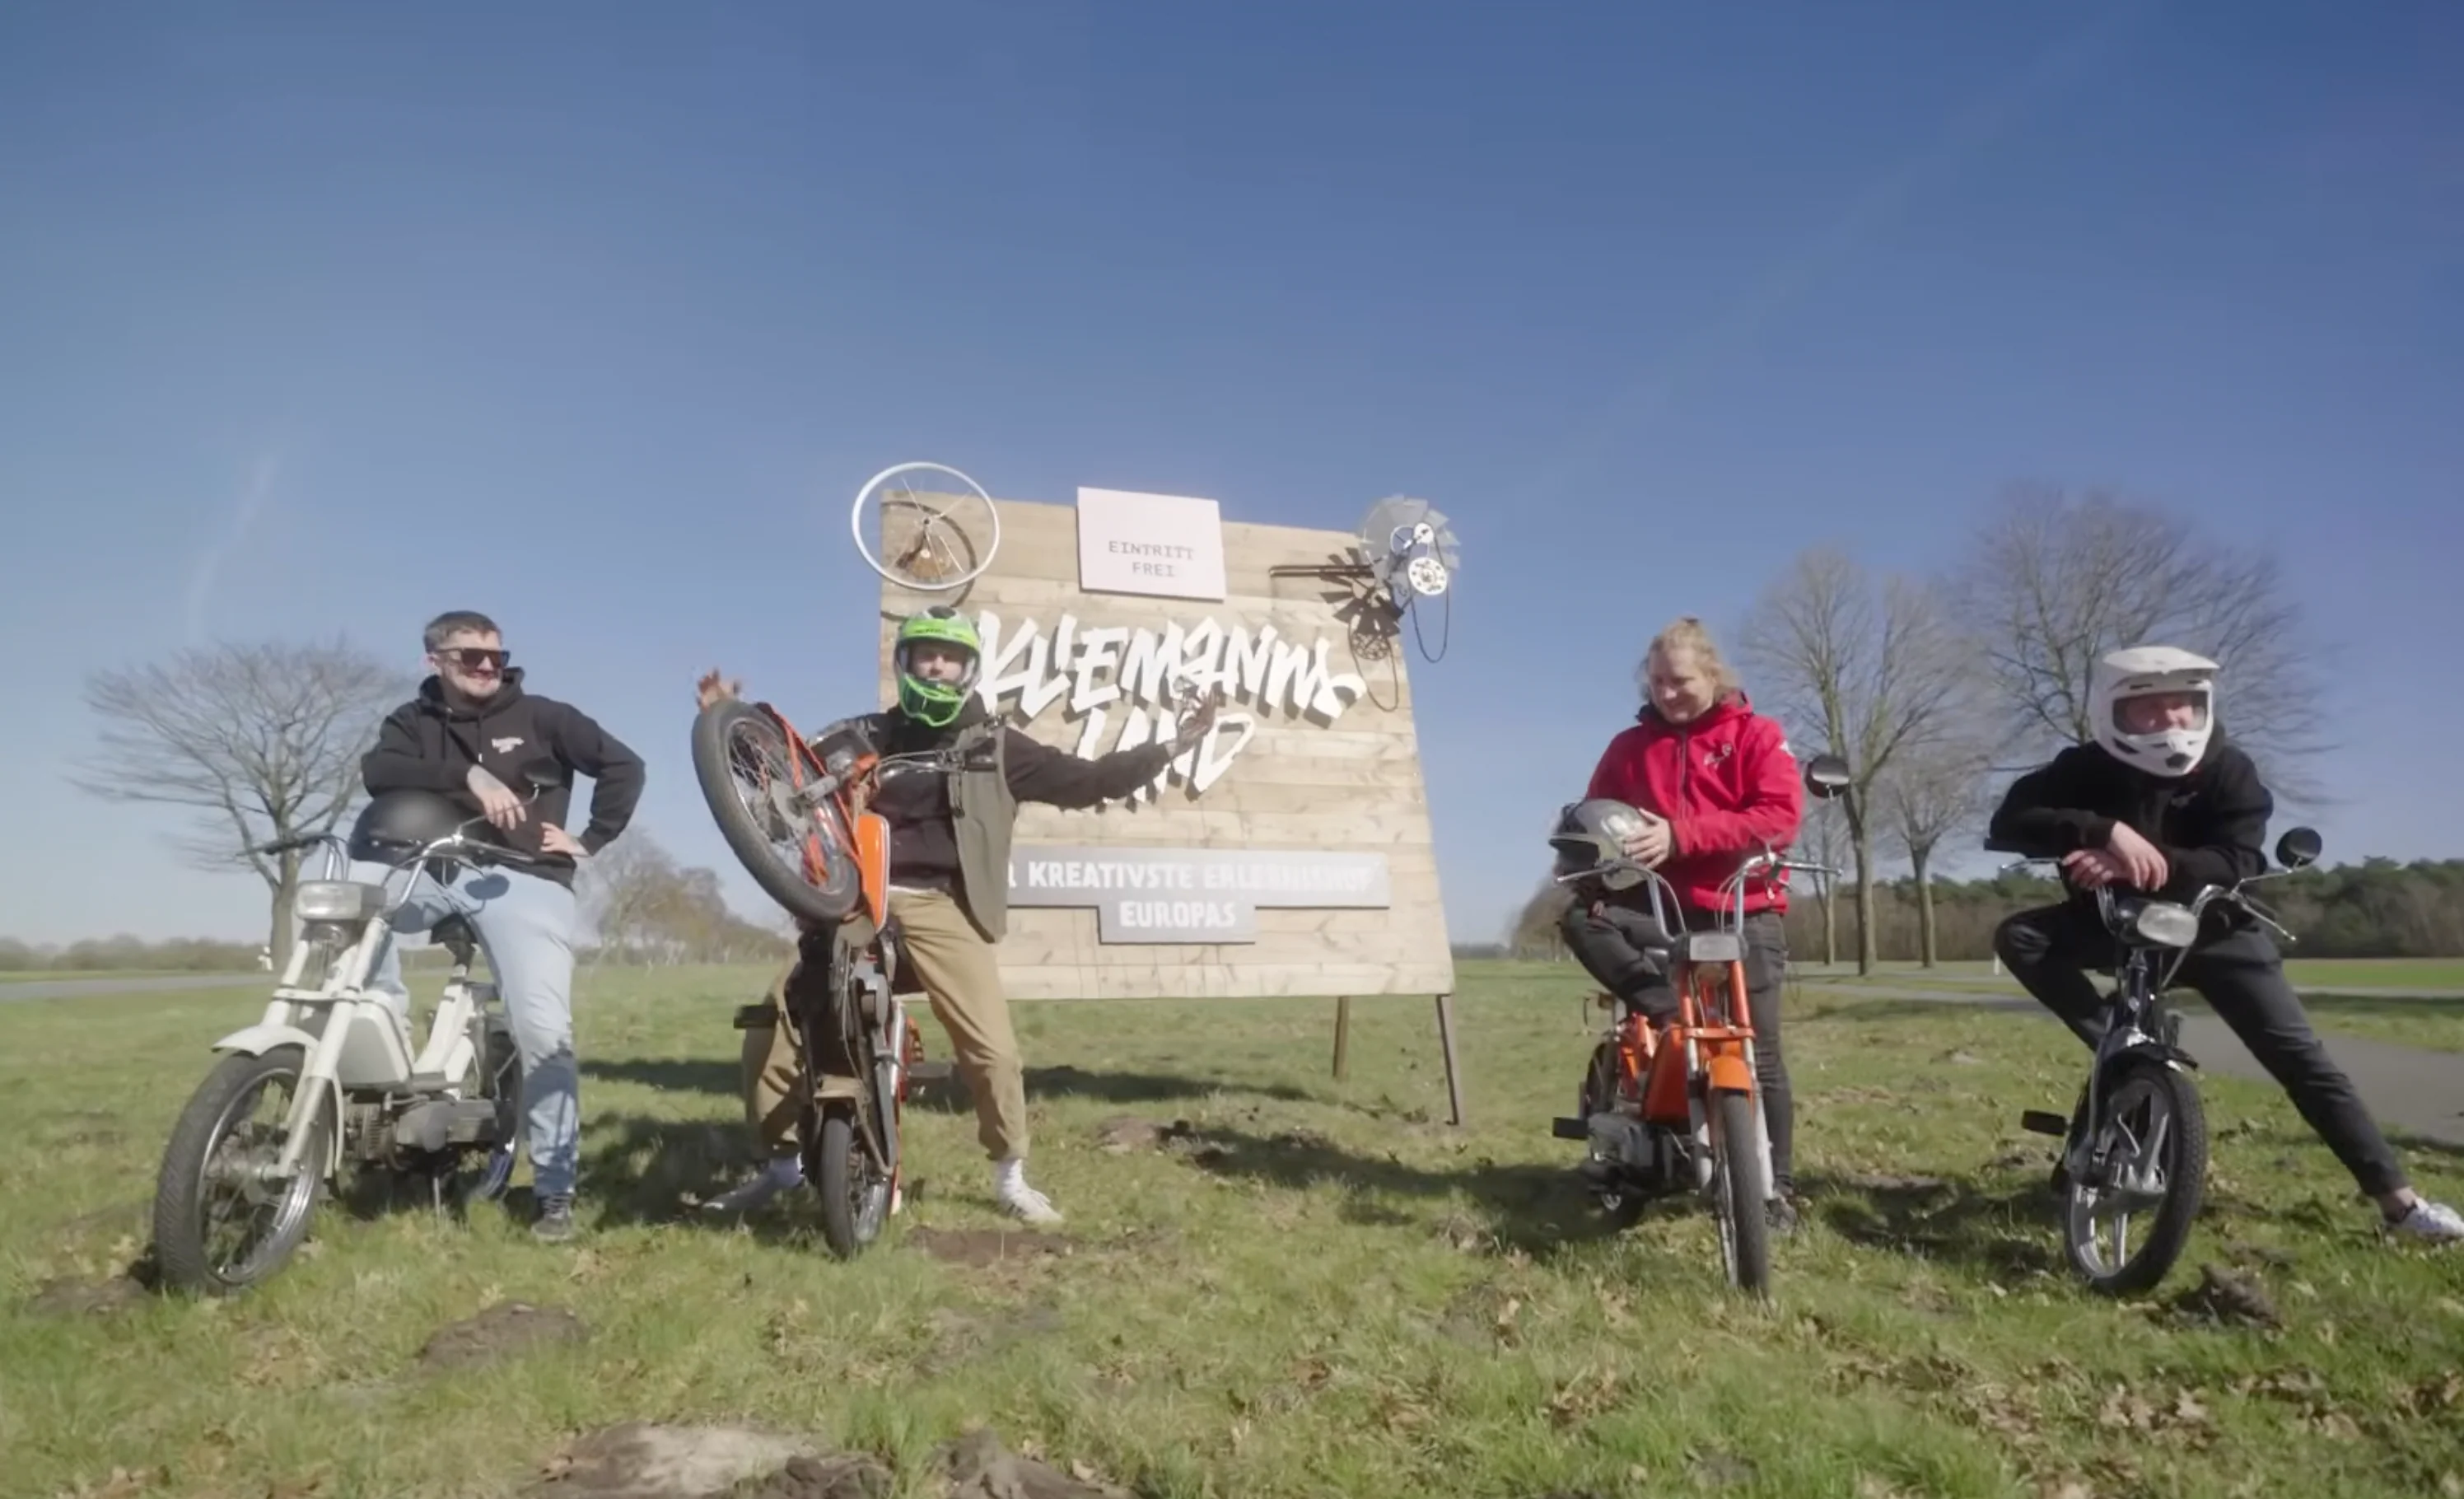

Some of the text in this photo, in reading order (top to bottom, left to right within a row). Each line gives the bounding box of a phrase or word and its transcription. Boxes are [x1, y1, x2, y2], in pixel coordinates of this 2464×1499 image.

[1108, 540, 1194, 560] EINTRITT
[1132, 562, 1176, 577] FREI
[1028, 861, 1194, 890] KREATIVSTE
[1119, 900, 1237, 929] EUROPAS
